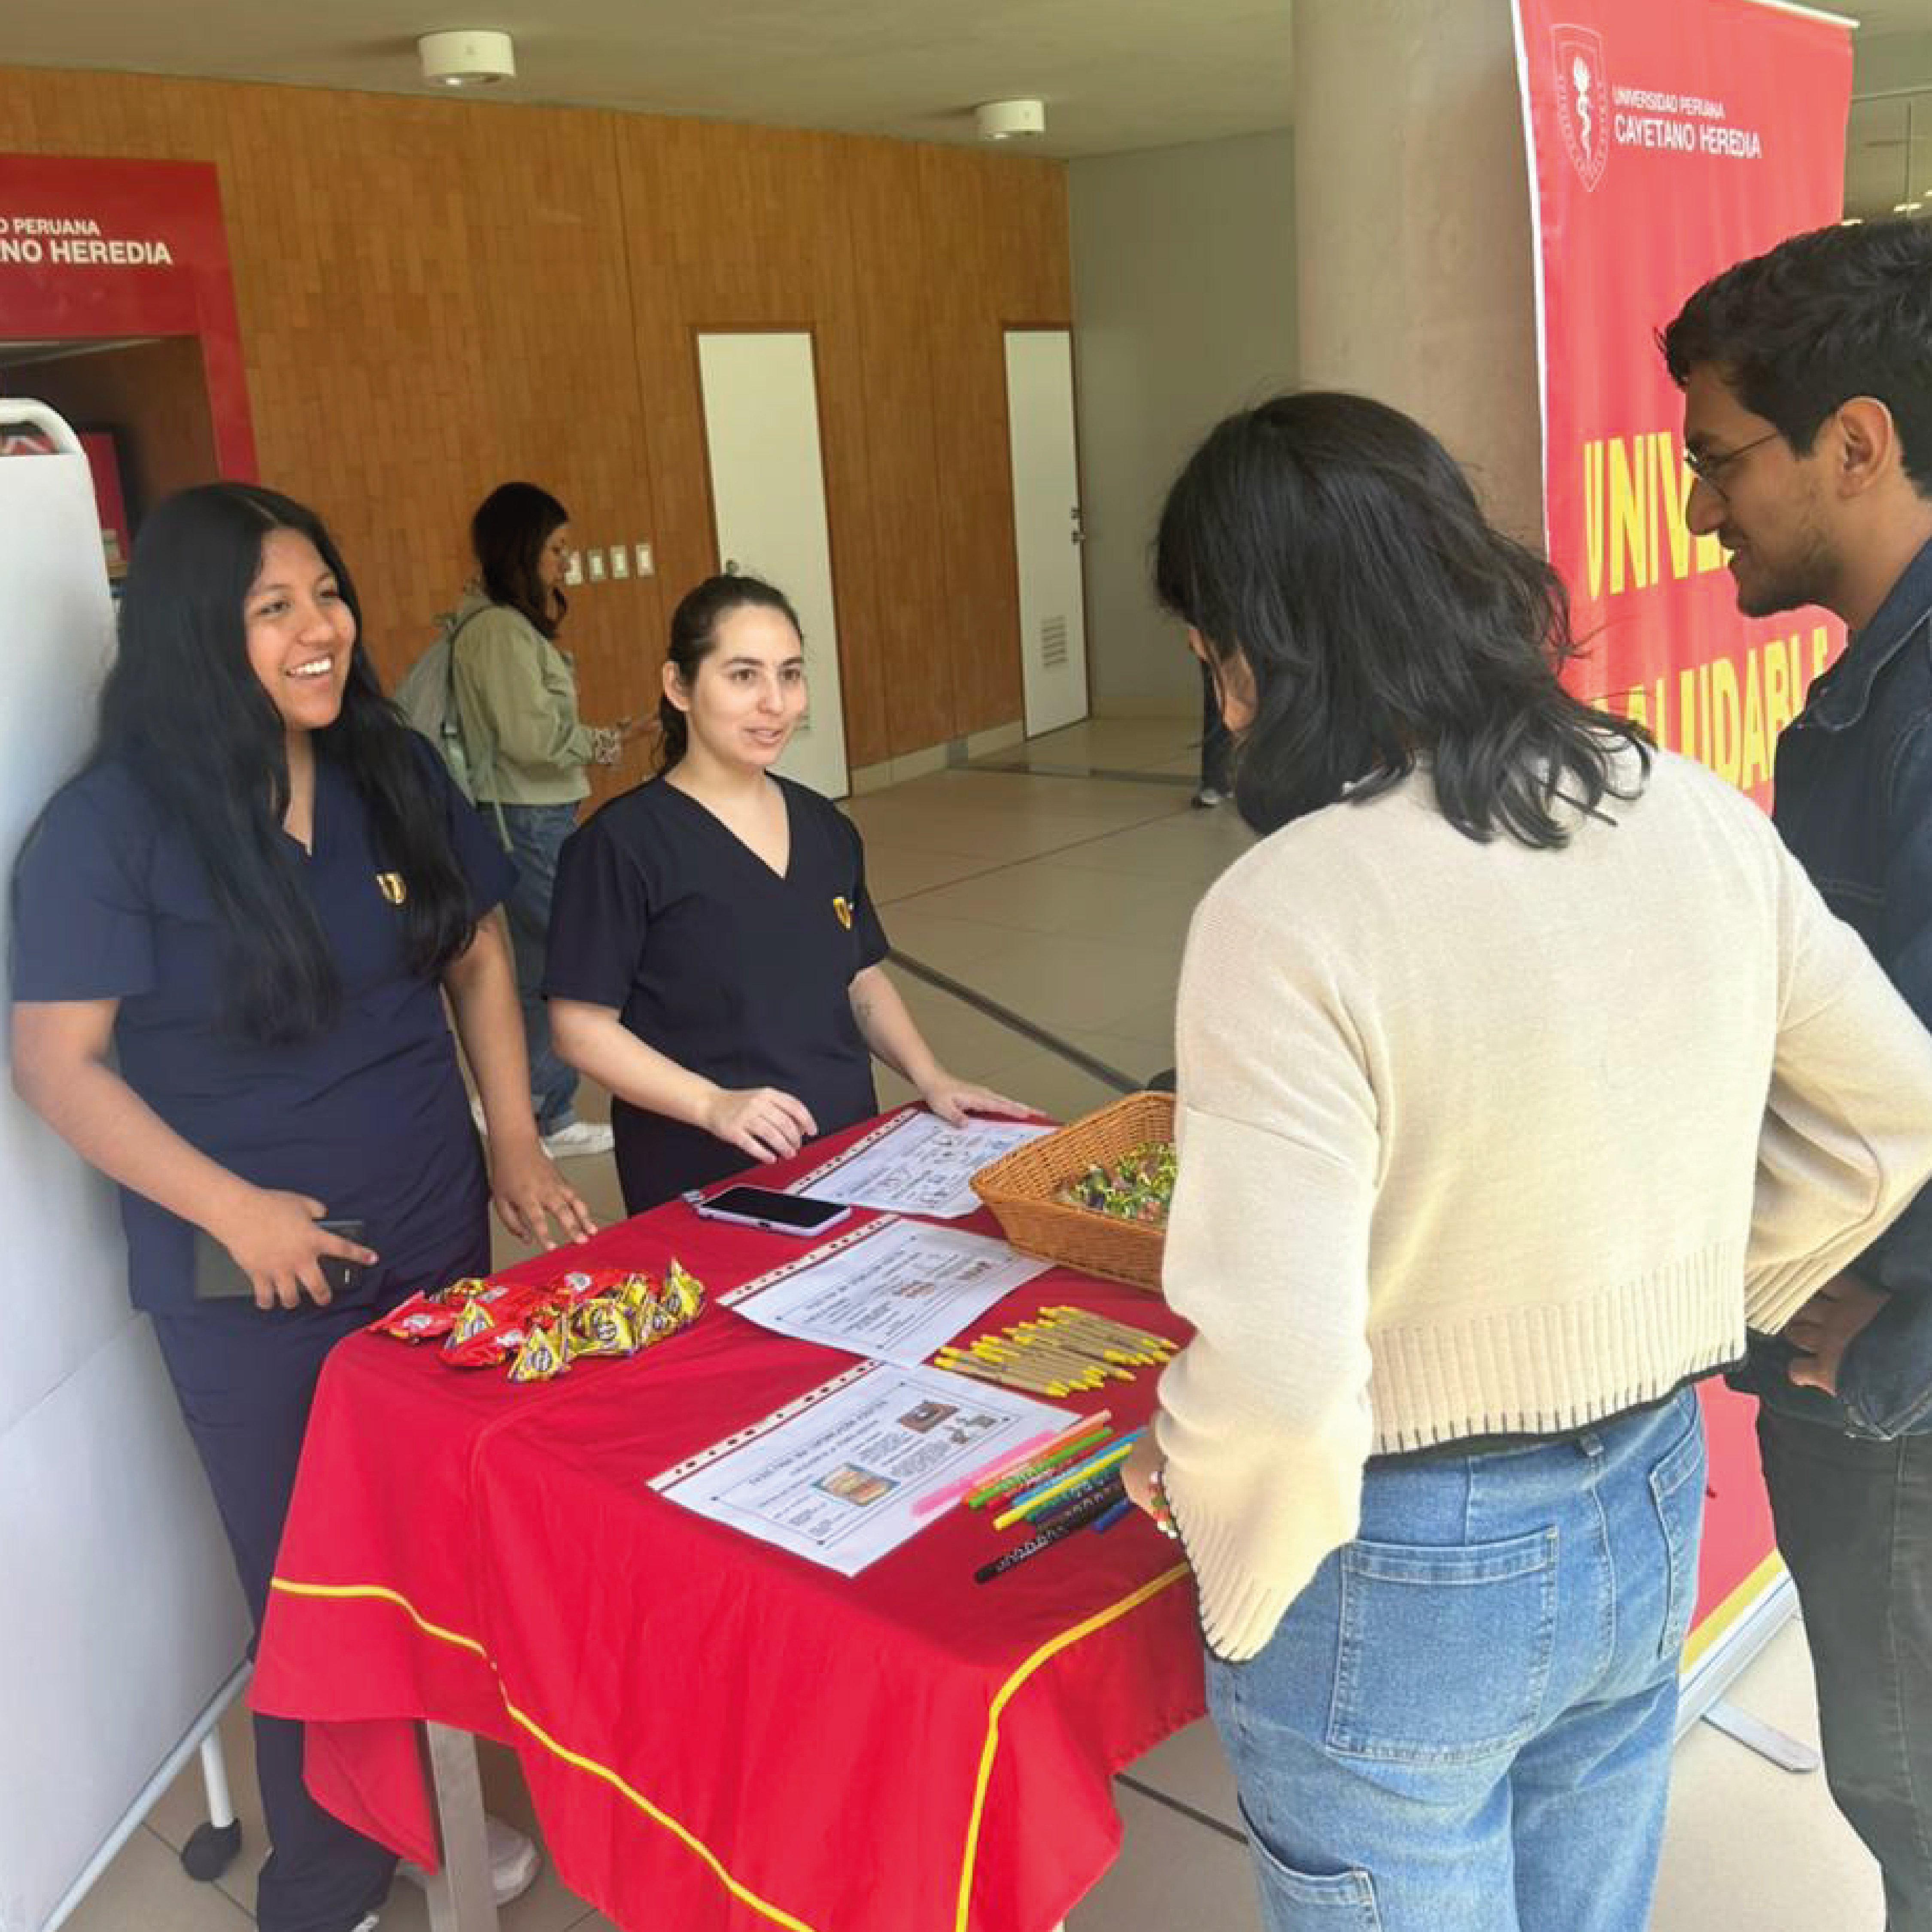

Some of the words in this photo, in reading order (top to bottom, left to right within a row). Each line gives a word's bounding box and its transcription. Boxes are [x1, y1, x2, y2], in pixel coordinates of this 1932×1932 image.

[1677, 97, 1725, 120] PERUANA
[1616, 114, 1695, 152] CAYETANO
[1699, 125, 1762, 159] HEREDIA
[12, 219, 102, 236] PERUANA
[50, 240, 173, 265] HEREDIA
[1584, 431, 1735, 600] UNIV
